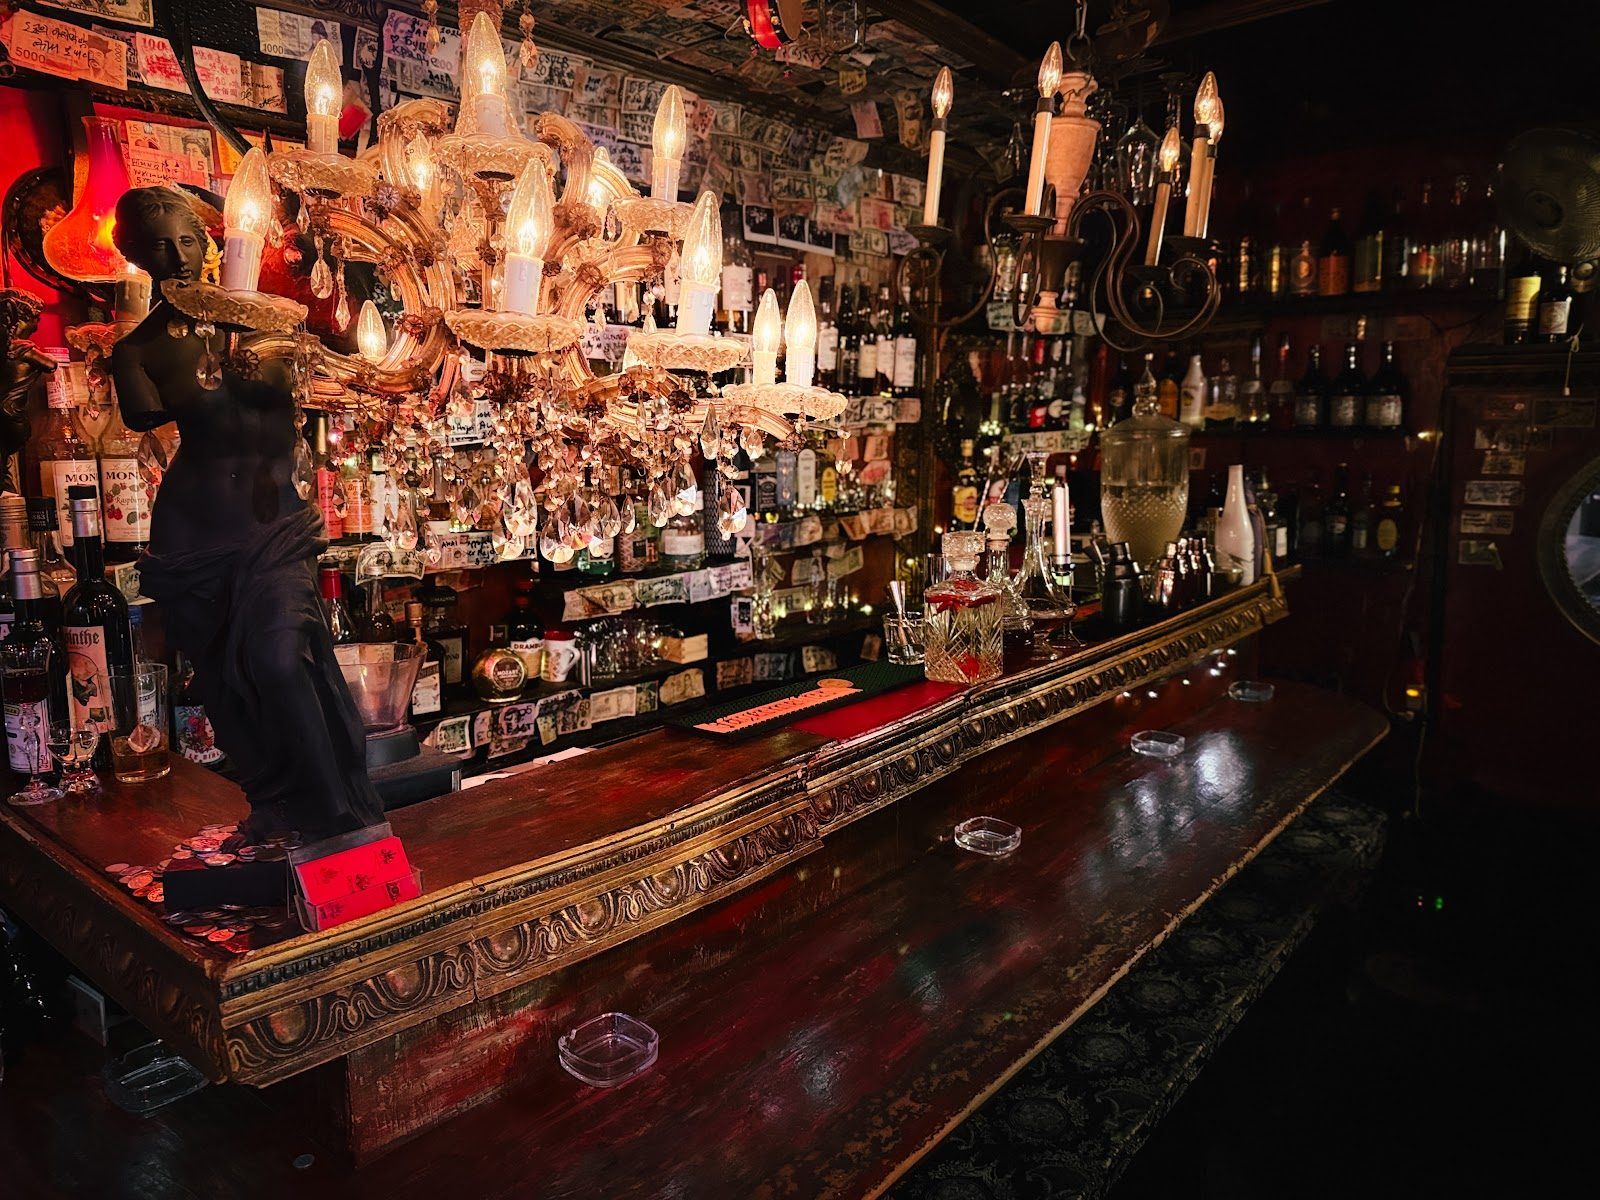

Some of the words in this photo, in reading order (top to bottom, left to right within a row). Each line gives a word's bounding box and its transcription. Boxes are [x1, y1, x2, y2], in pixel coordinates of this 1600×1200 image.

[262, 42, 284, 54] 1000
[15, 46, 46, 64] 5000
[197, 160, 205, 171] 5
[115, 497, 147, 507] Raspberry
